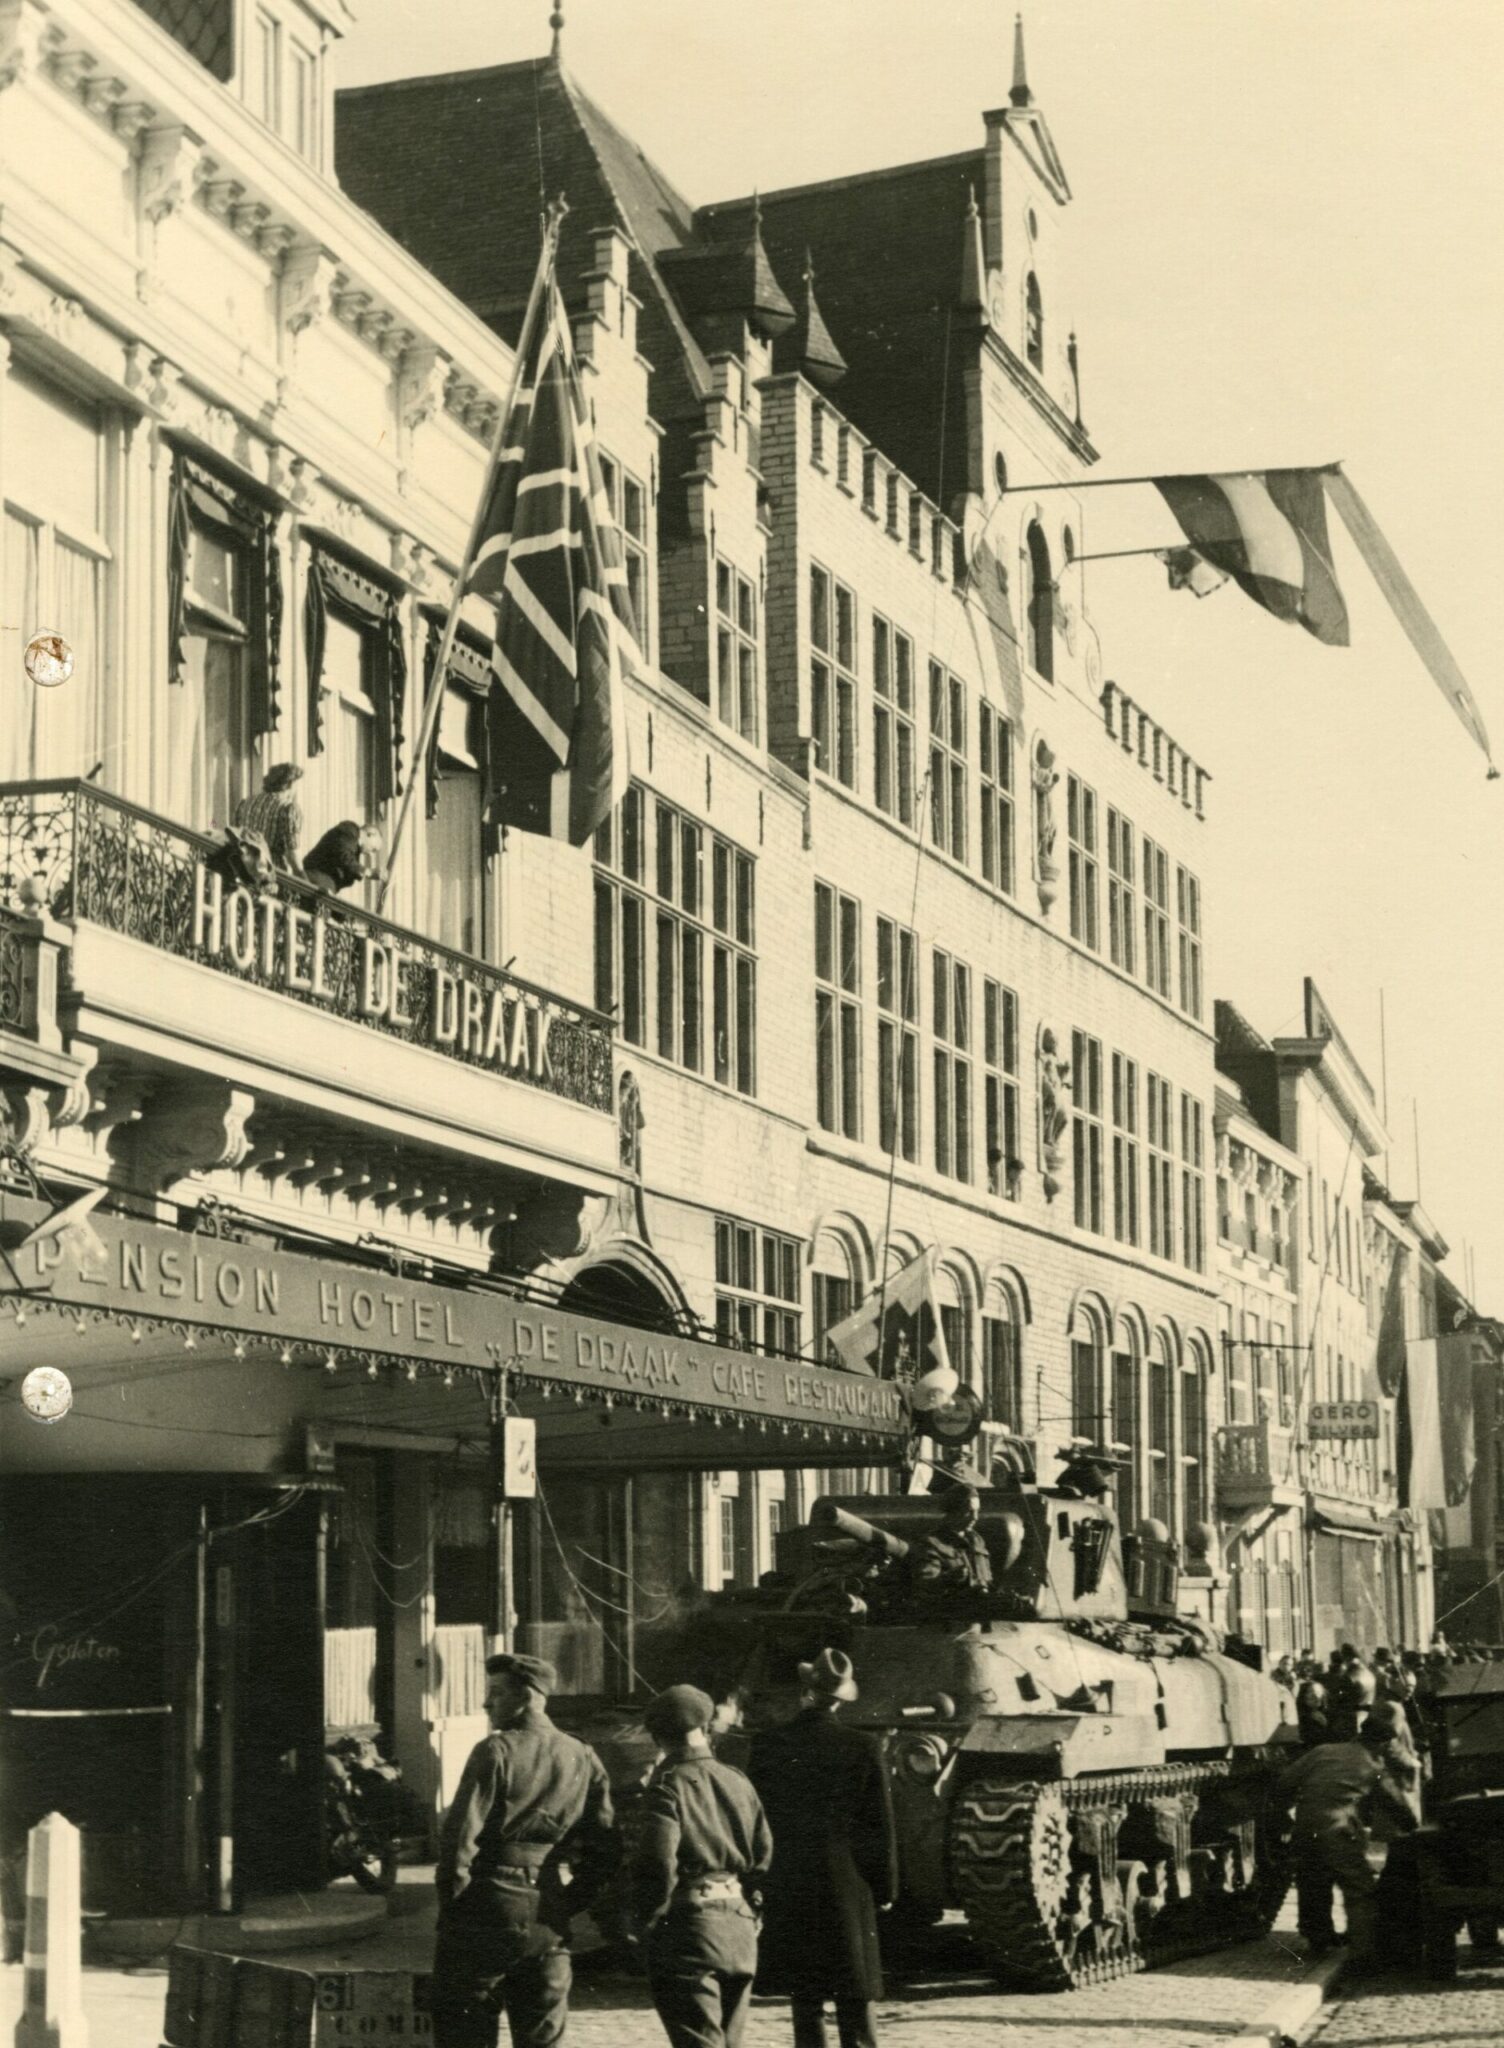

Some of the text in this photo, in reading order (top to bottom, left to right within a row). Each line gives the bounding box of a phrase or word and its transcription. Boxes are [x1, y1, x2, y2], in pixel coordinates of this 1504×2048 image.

[195, 863, 554, 1079] HOTEL DE DRAAK
[319, 1280, 464, 1347] HOTEL
[712, 1360, 766, 1402] CAFE
[783, 1374, 902, 1424] RESTAURANT
[1311, 1405, 1372, 1420] GERO
